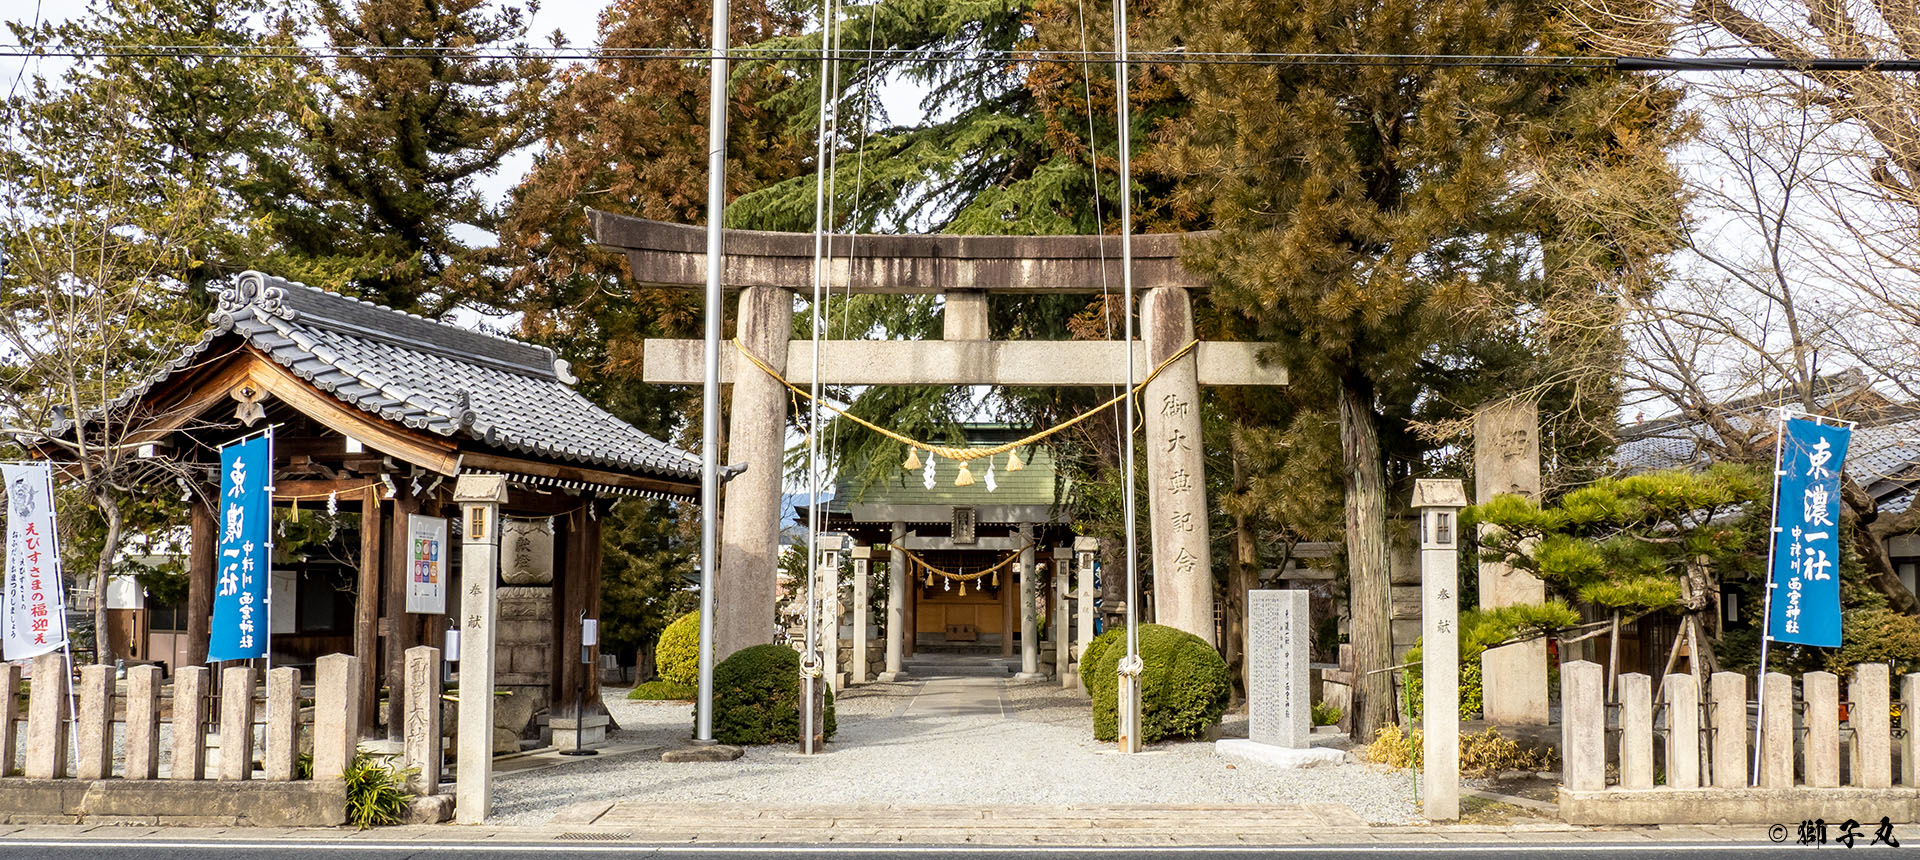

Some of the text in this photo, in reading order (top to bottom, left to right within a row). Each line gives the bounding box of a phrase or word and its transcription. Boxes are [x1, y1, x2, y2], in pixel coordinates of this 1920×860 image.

[1161, 394, 1198, 573] 御大典記念
[1802, 436, 1834, 581] 東濃一社
[25, 522, 49, 645] えびすさまの福迎え
